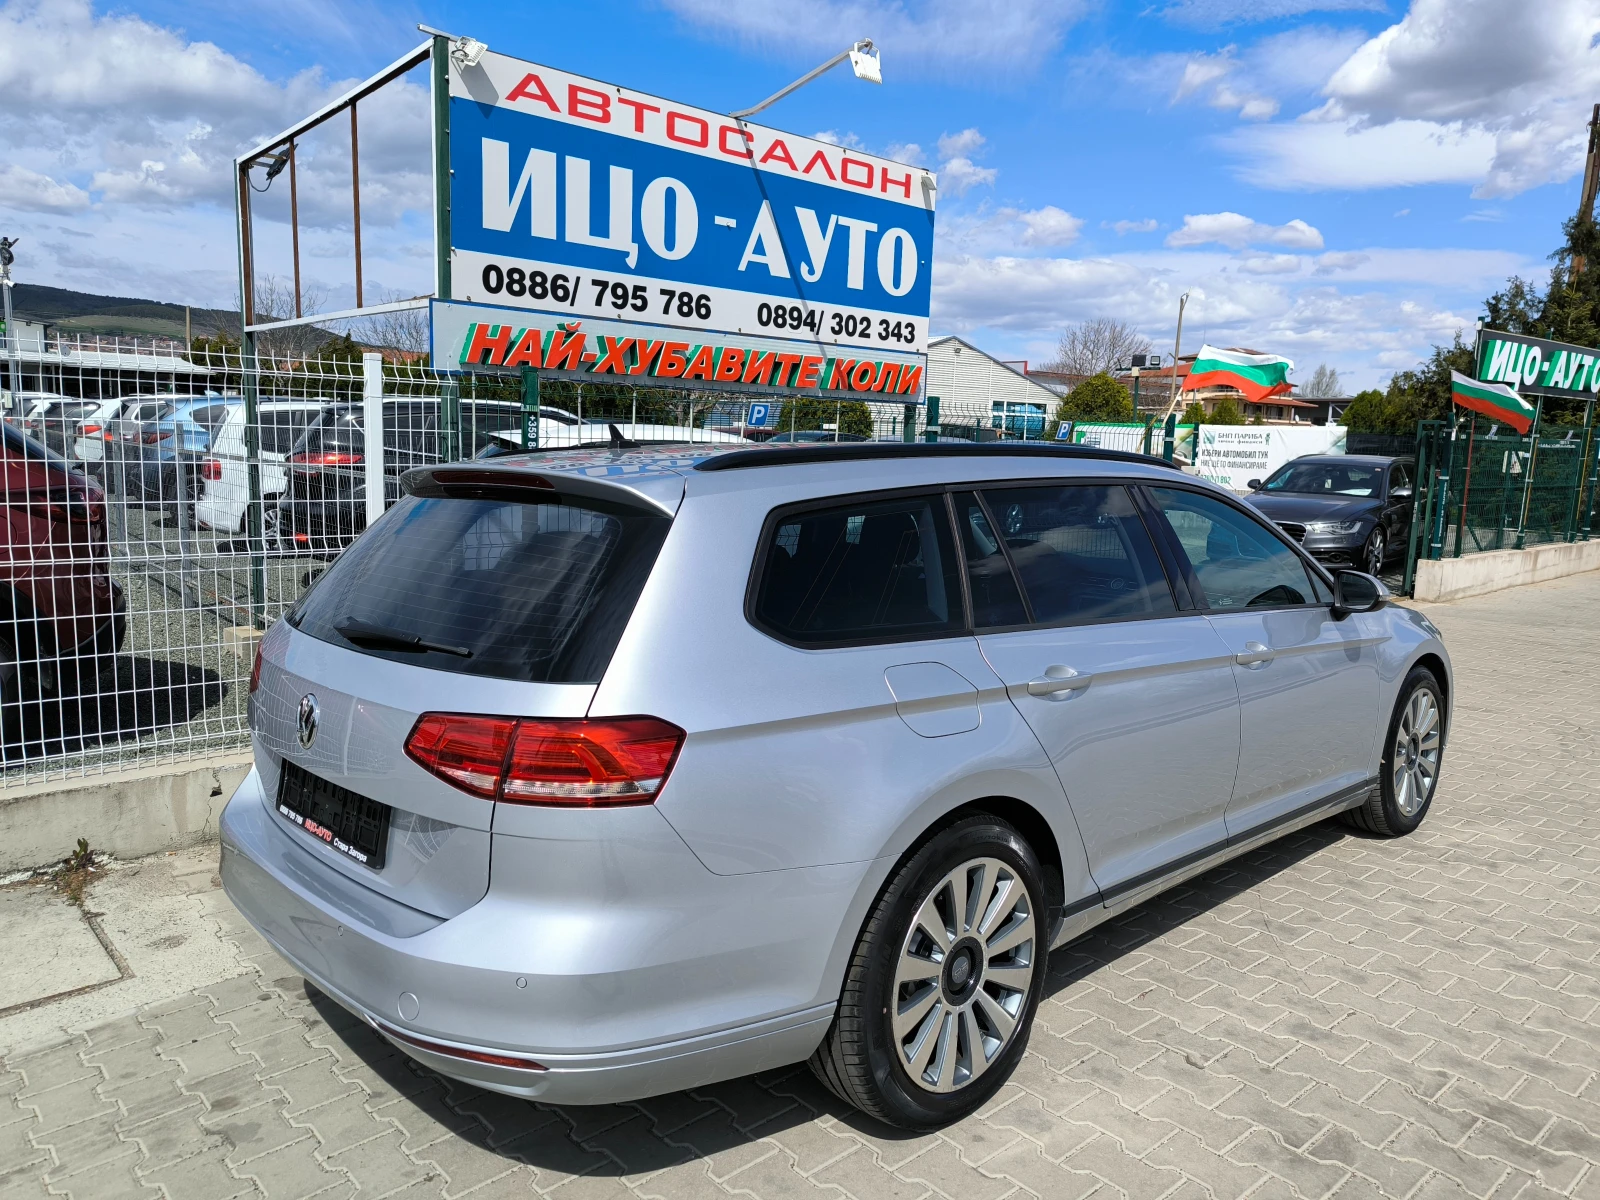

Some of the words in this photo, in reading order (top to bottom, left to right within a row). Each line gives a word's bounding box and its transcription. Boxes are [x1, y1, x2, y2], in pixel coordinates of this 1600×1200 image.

[504, 72, 912, 199] АВТОСАЛОН
[481, 263, 581, 307] 0886/
[591, 278, 649, 312] 795
[659, 288, 712, 320] 786
[756, 302, 825, 336] 0894/
[830, 312, 871, 339] 302
[877, 318, 916, 344] 343
[463, 321, 824, 389] НАЙ-ХУБАВИТЕ
[824, 357, 923, 395] КОЛИ
[527, 414, 537, 439] +359
[527, 441, 537, 449] 8
[1201, 448, 1222, 458] ИЗБЕРИ
[1222, 450, 1257, 459] АВТОМОБИЛ
[1257, 451, 1269, 459] ТУК
[1200, 459, 1210, 467] НИЕ
[1227, 460, 1268, 470] ФИНАНСИРАМЕ
